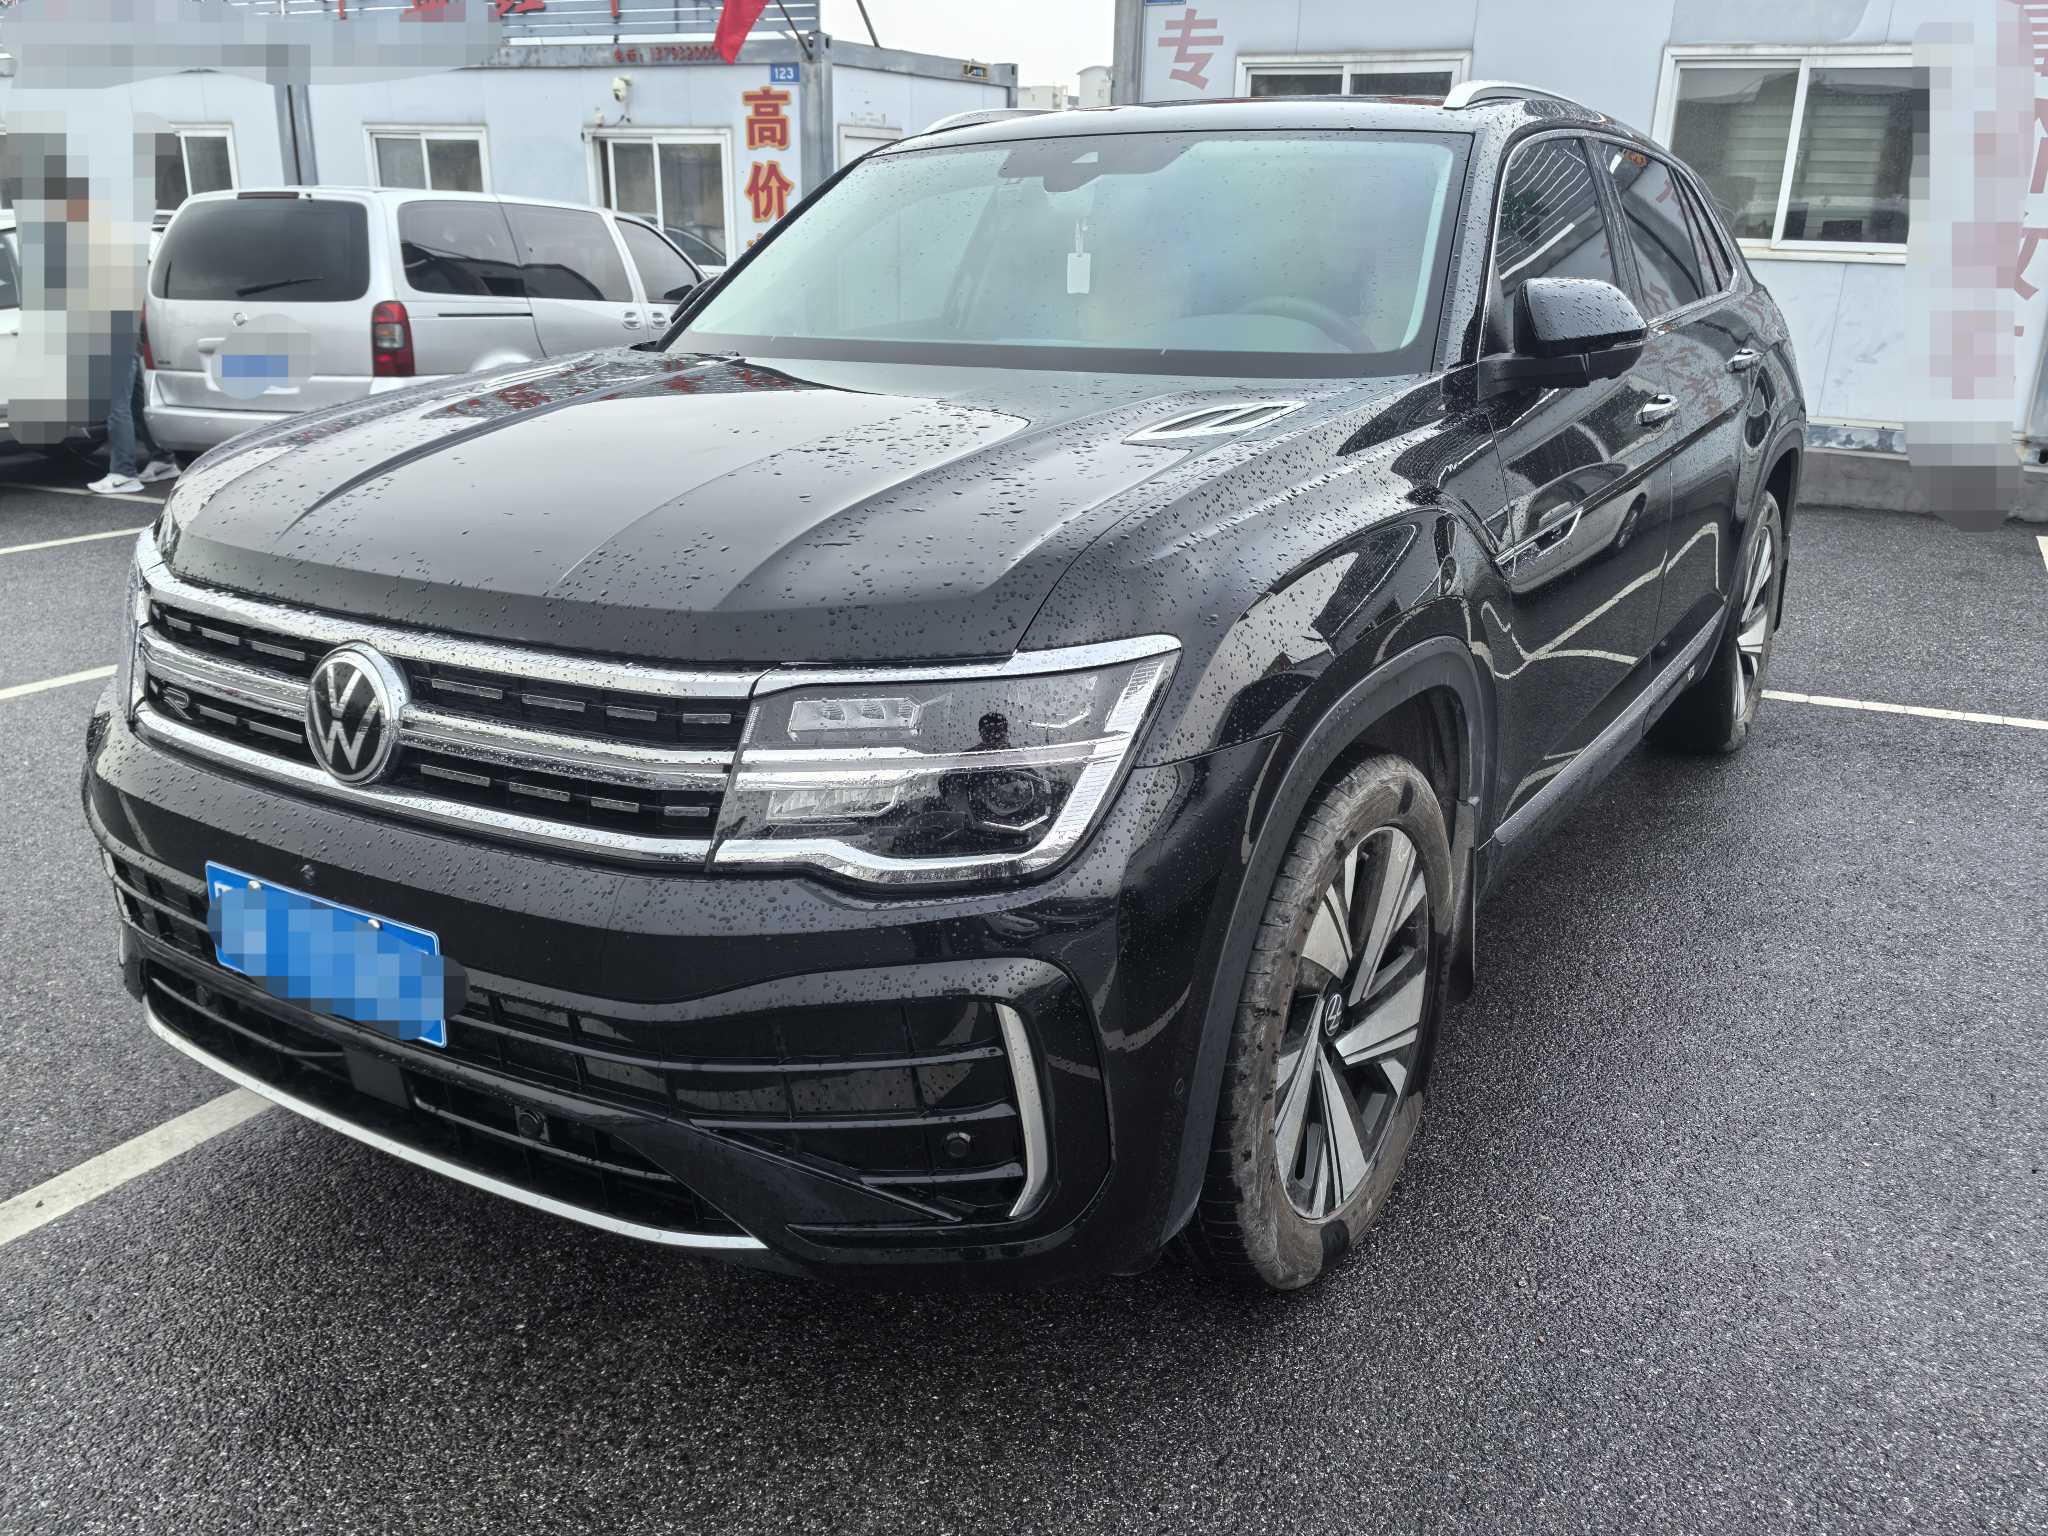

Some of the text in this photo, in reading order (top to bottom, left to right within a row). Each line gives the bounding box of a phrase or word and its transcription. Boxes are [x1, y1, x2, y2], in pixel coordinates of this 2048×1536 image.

[774, 67, 794, 80] 123
[1158, 8, 1224, 90] 专
[743, 86, 795, 245] 高价
